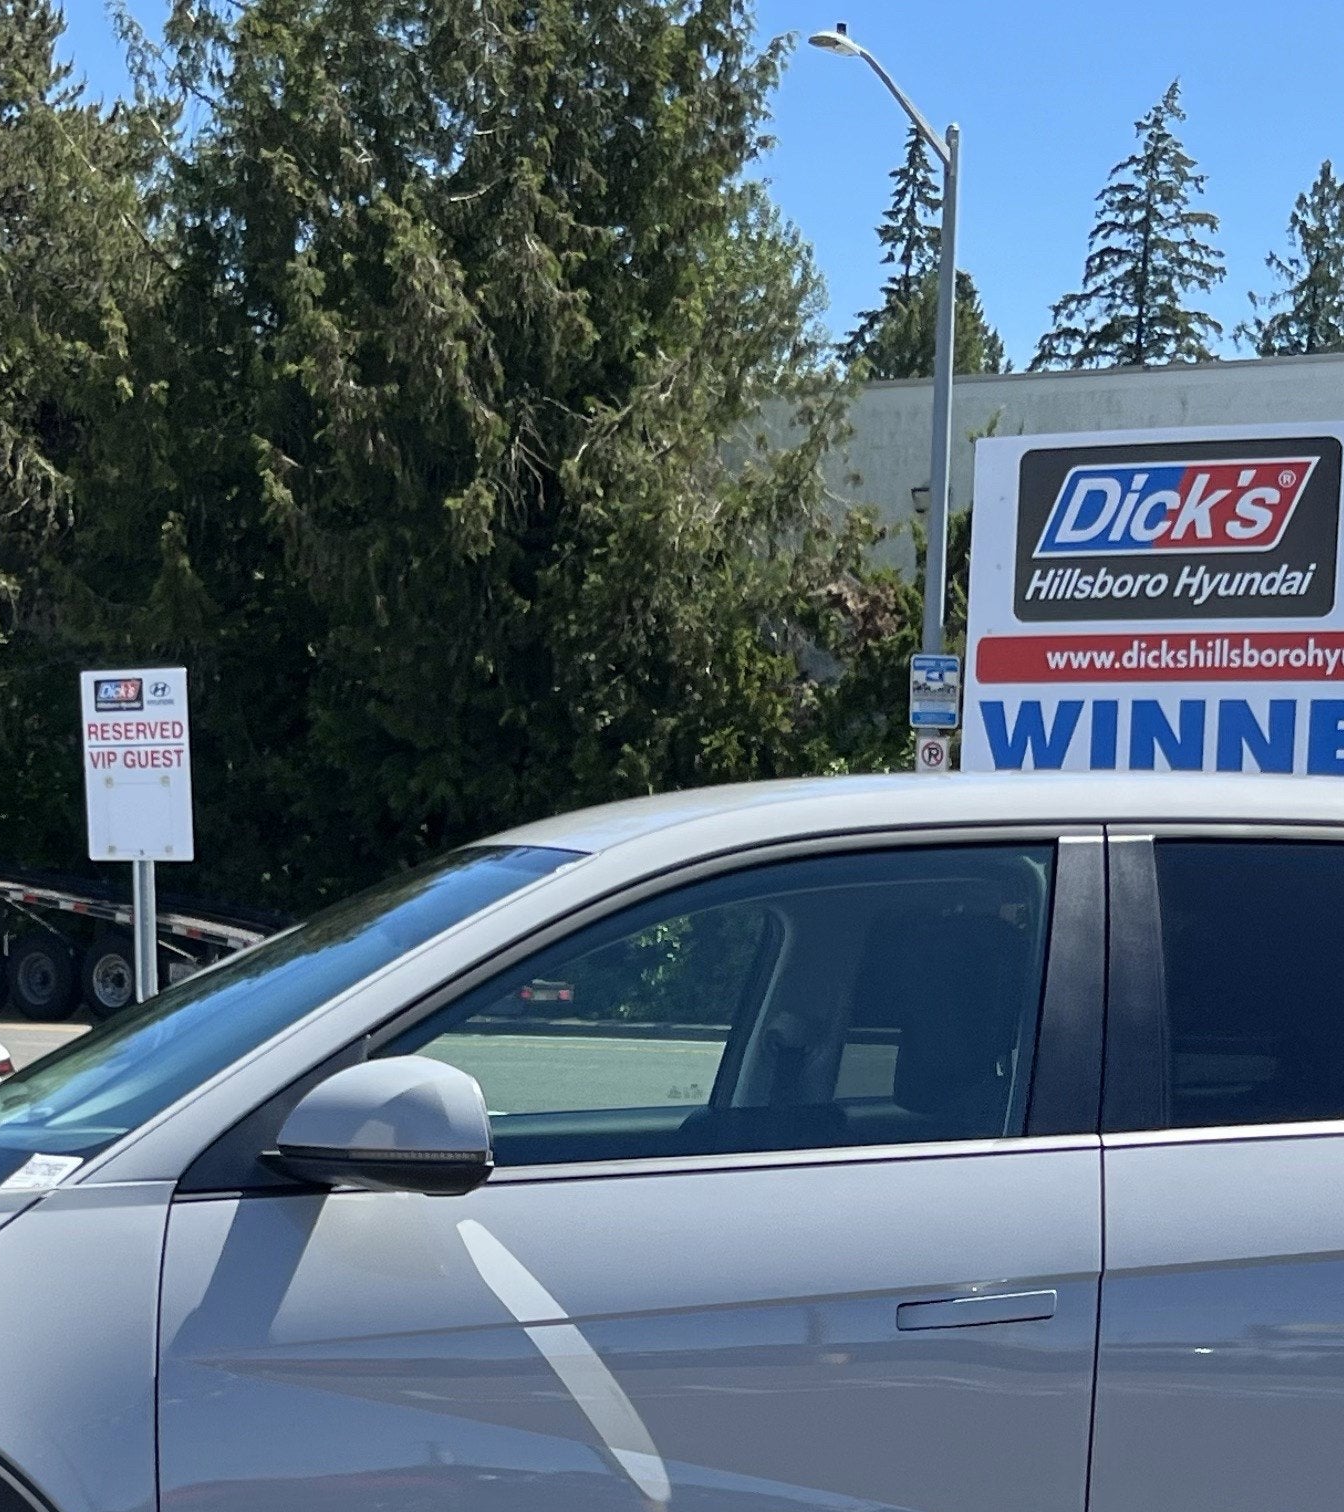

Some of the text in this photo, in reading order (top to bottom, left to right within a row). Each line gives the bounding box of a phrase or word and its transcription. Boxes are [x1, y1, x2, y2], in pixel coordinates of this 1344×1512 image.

[1054, 467, 1283, 544] Dick's
[1025, 562, 1317, 606] Hillsboro Hyundai
[87, 721, 184, 741] RESERVED
[89, 749, 184, 769] VIP GUEST
